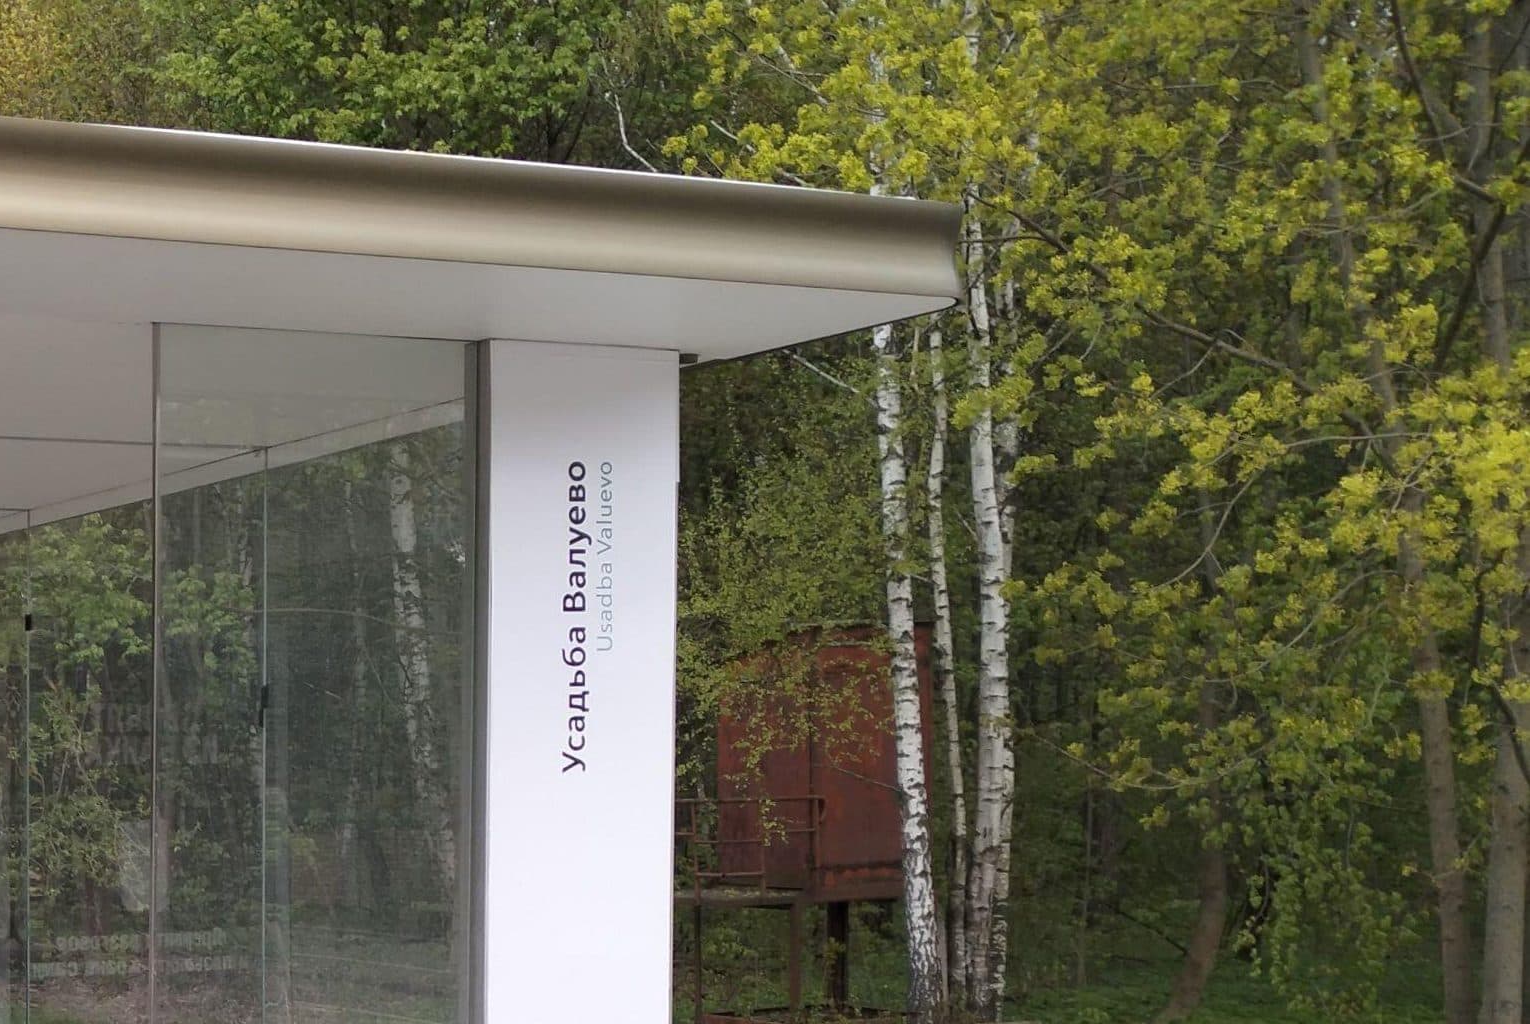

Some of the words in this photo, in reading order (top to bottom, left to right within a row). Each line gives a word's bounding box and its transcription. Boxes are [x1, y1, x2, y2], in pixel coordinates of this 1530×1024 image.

[563, 460, 591, 612] Валуево
[596, 461, 613, 555] Valuevo
[596, 562, 613, 651] Usadba
[562, 626, 589, 773] Усадьба
